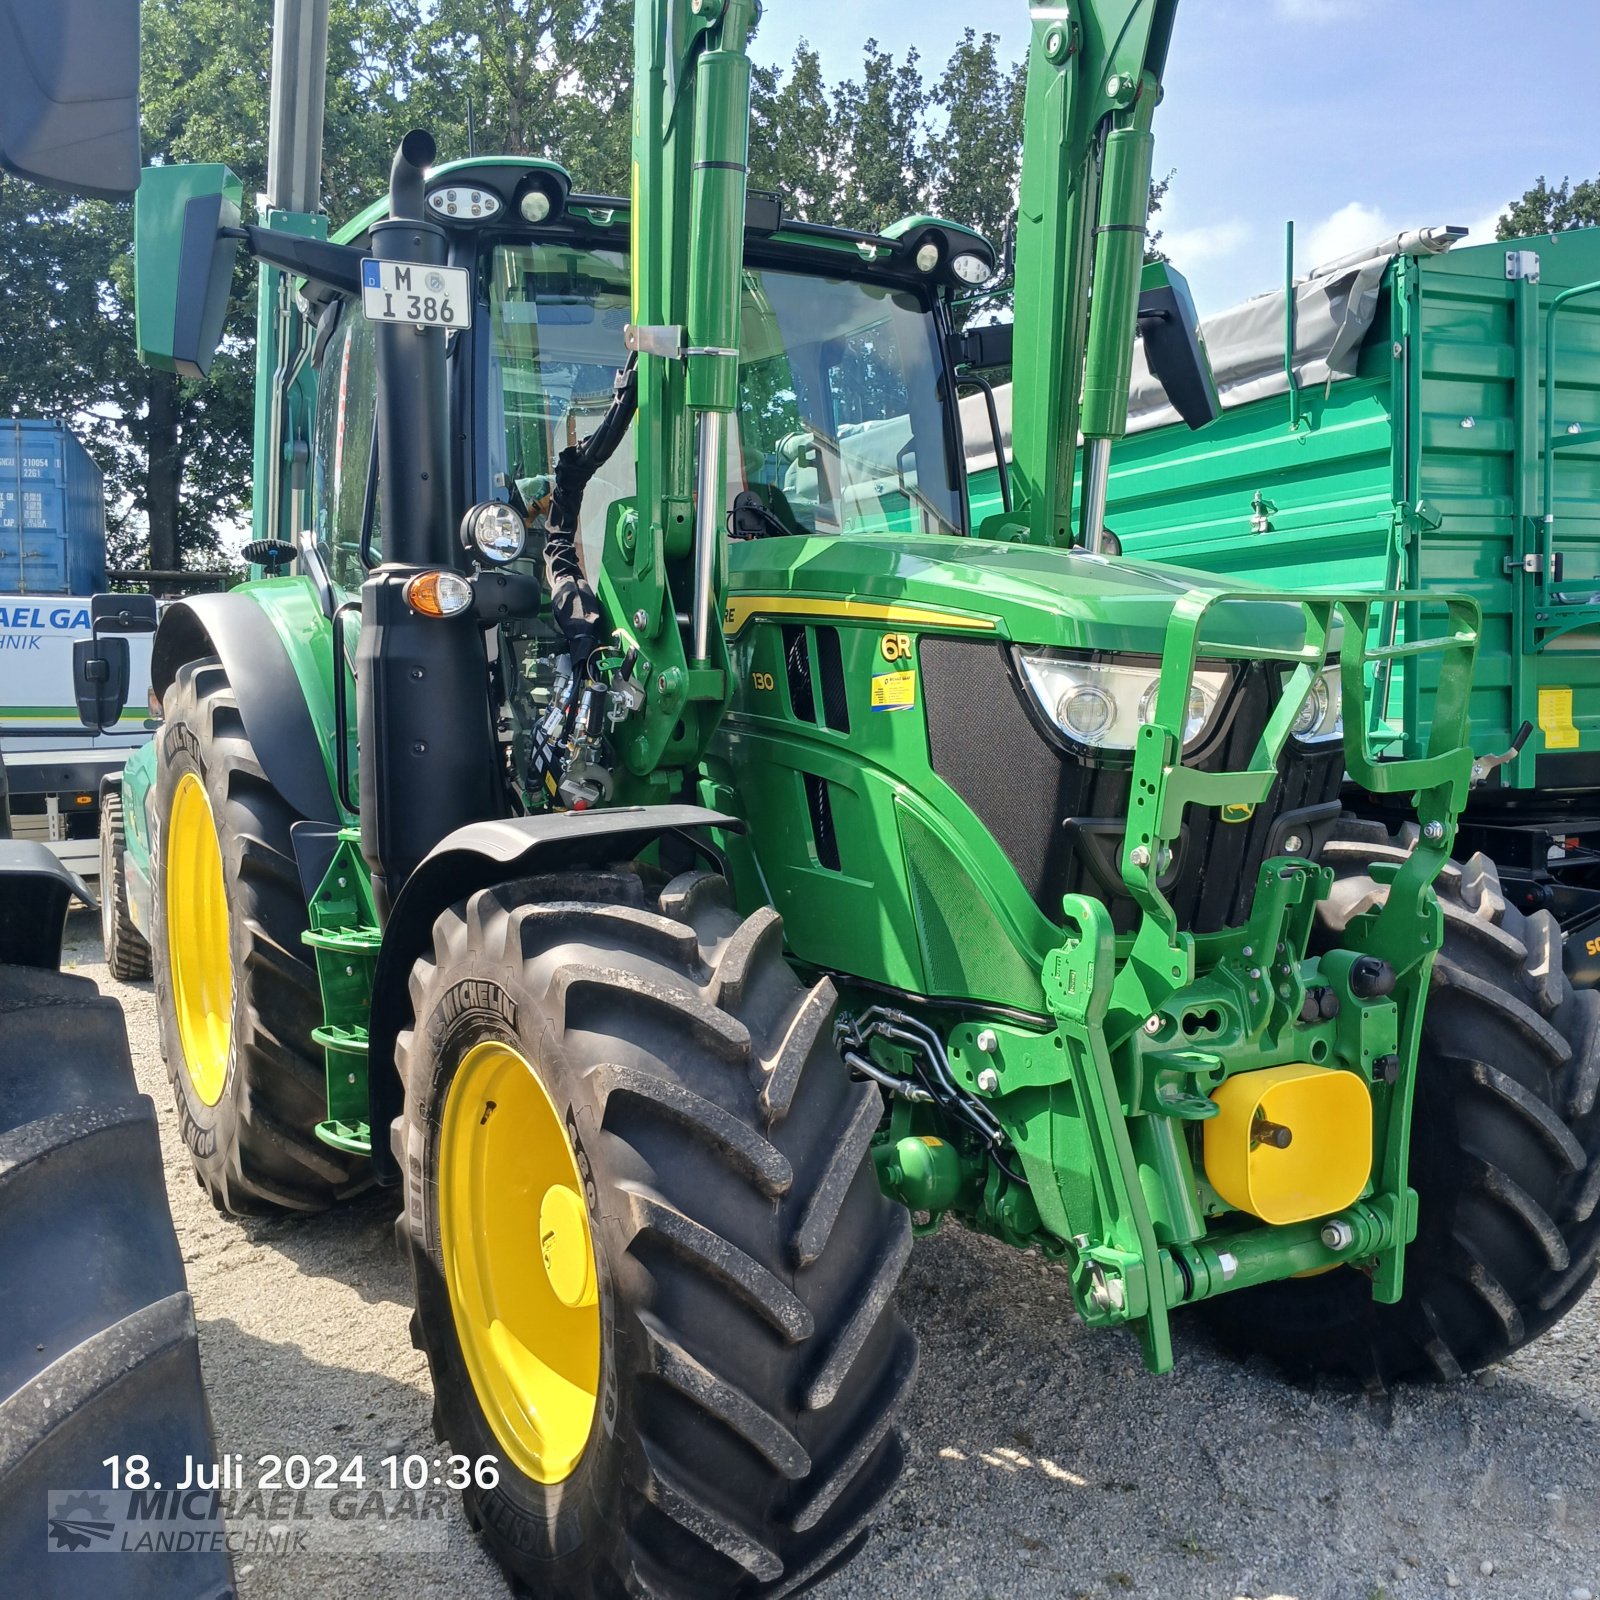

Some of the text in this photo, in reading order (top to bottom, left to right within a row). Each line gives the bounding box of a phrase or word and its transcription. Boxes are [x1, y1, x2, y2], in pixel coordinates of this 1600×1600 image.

[369, 278, 376, 286] D
[395, 266, 411, 291] M
[383, 293, 454, 322] I 386
[23, 459, 48, 467] 210054
[24, 469, 40, 477] 22G1
[881, 632, 912, 662] 6R
[752, 672, 774, 691] 130
[441, 981, 516, 1028] MICHELIN
